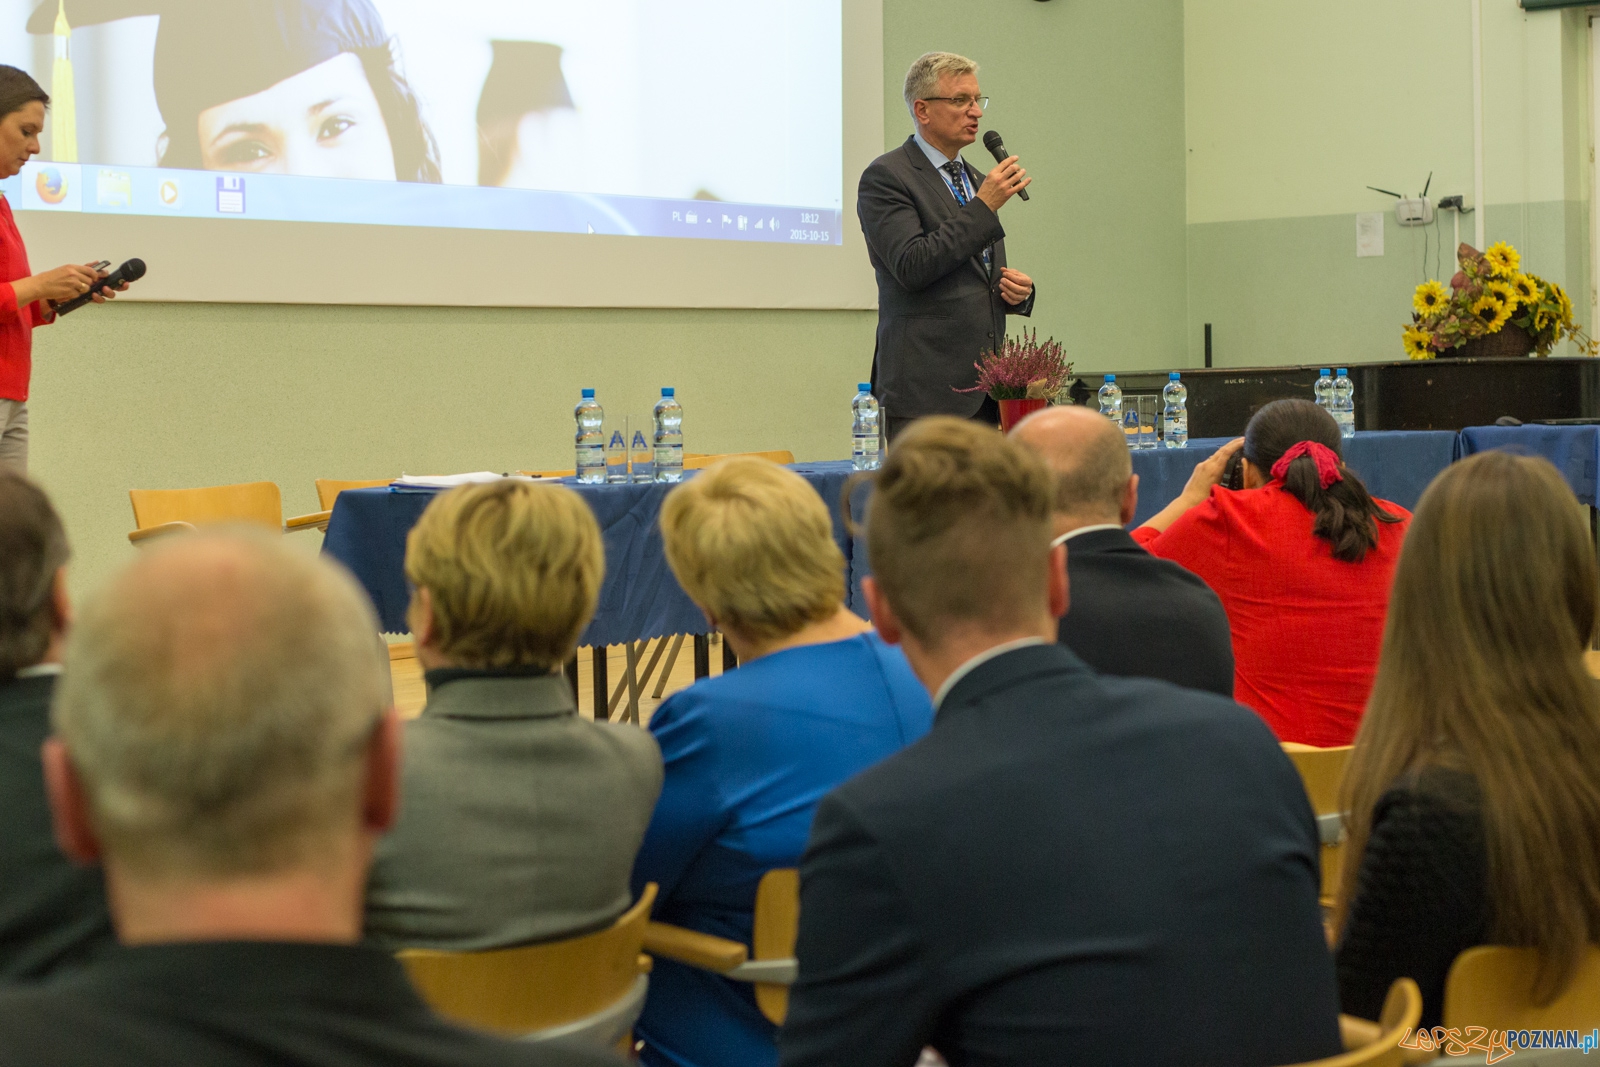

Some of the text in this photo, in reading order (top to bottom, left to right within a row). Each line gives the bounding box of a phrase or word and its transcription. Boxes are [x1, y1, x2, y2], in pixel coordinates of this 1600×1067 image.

[672, 211, 682, 222] PL
[801, 212, 820, 224] 18:12
[790, 229, 830, 242] 2015-10-15
